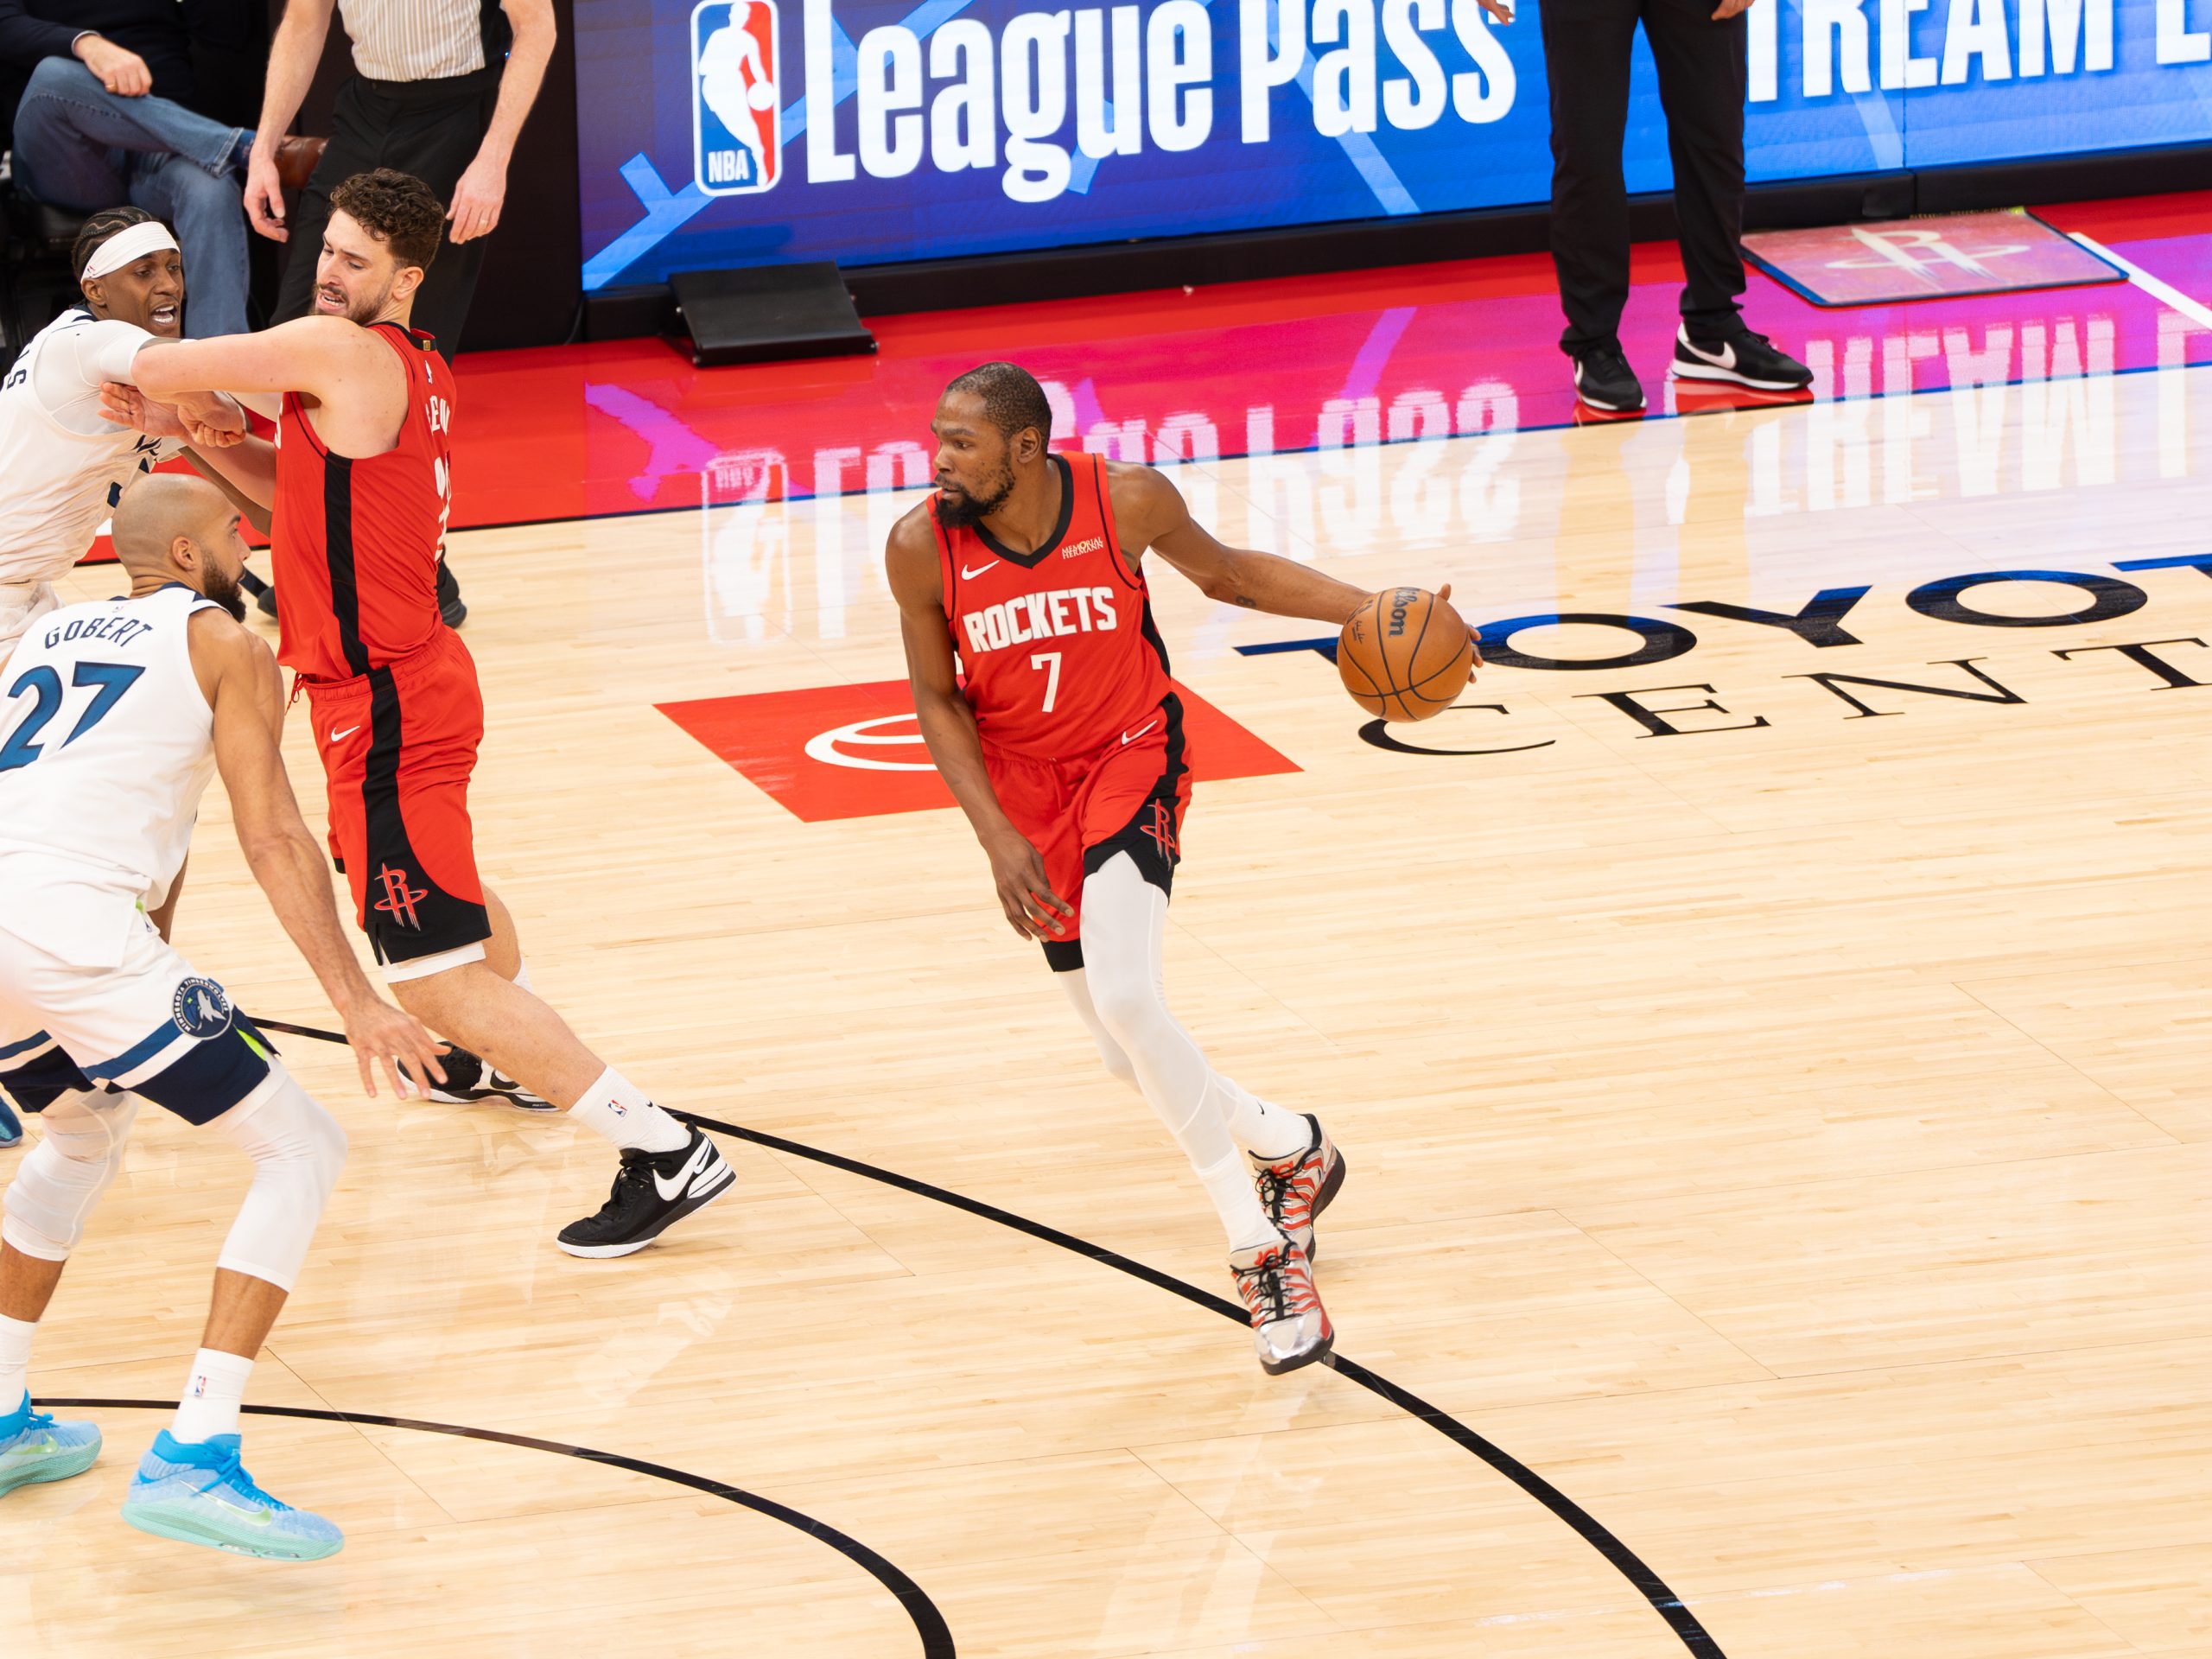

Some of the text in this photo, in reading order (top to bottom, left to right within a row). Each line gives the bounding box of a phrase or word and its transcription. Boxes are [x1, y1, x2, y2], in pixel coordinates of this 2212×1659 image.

[1747, 0, 2113, 102] TREAM
[804, 0, 1516, 203] League Pass
[708, 149, 750, 183] NBA
[1062, 537, 1103, 554] MEMORIAL
[45, 617, 153, 649] GOBERT
[963, 587, 1117, 653] ROCKETS
[1031, 652, 1062, 712] 7
[1358, 637, 2212, 755] CENT
[0, 661, 146, 772] 27
